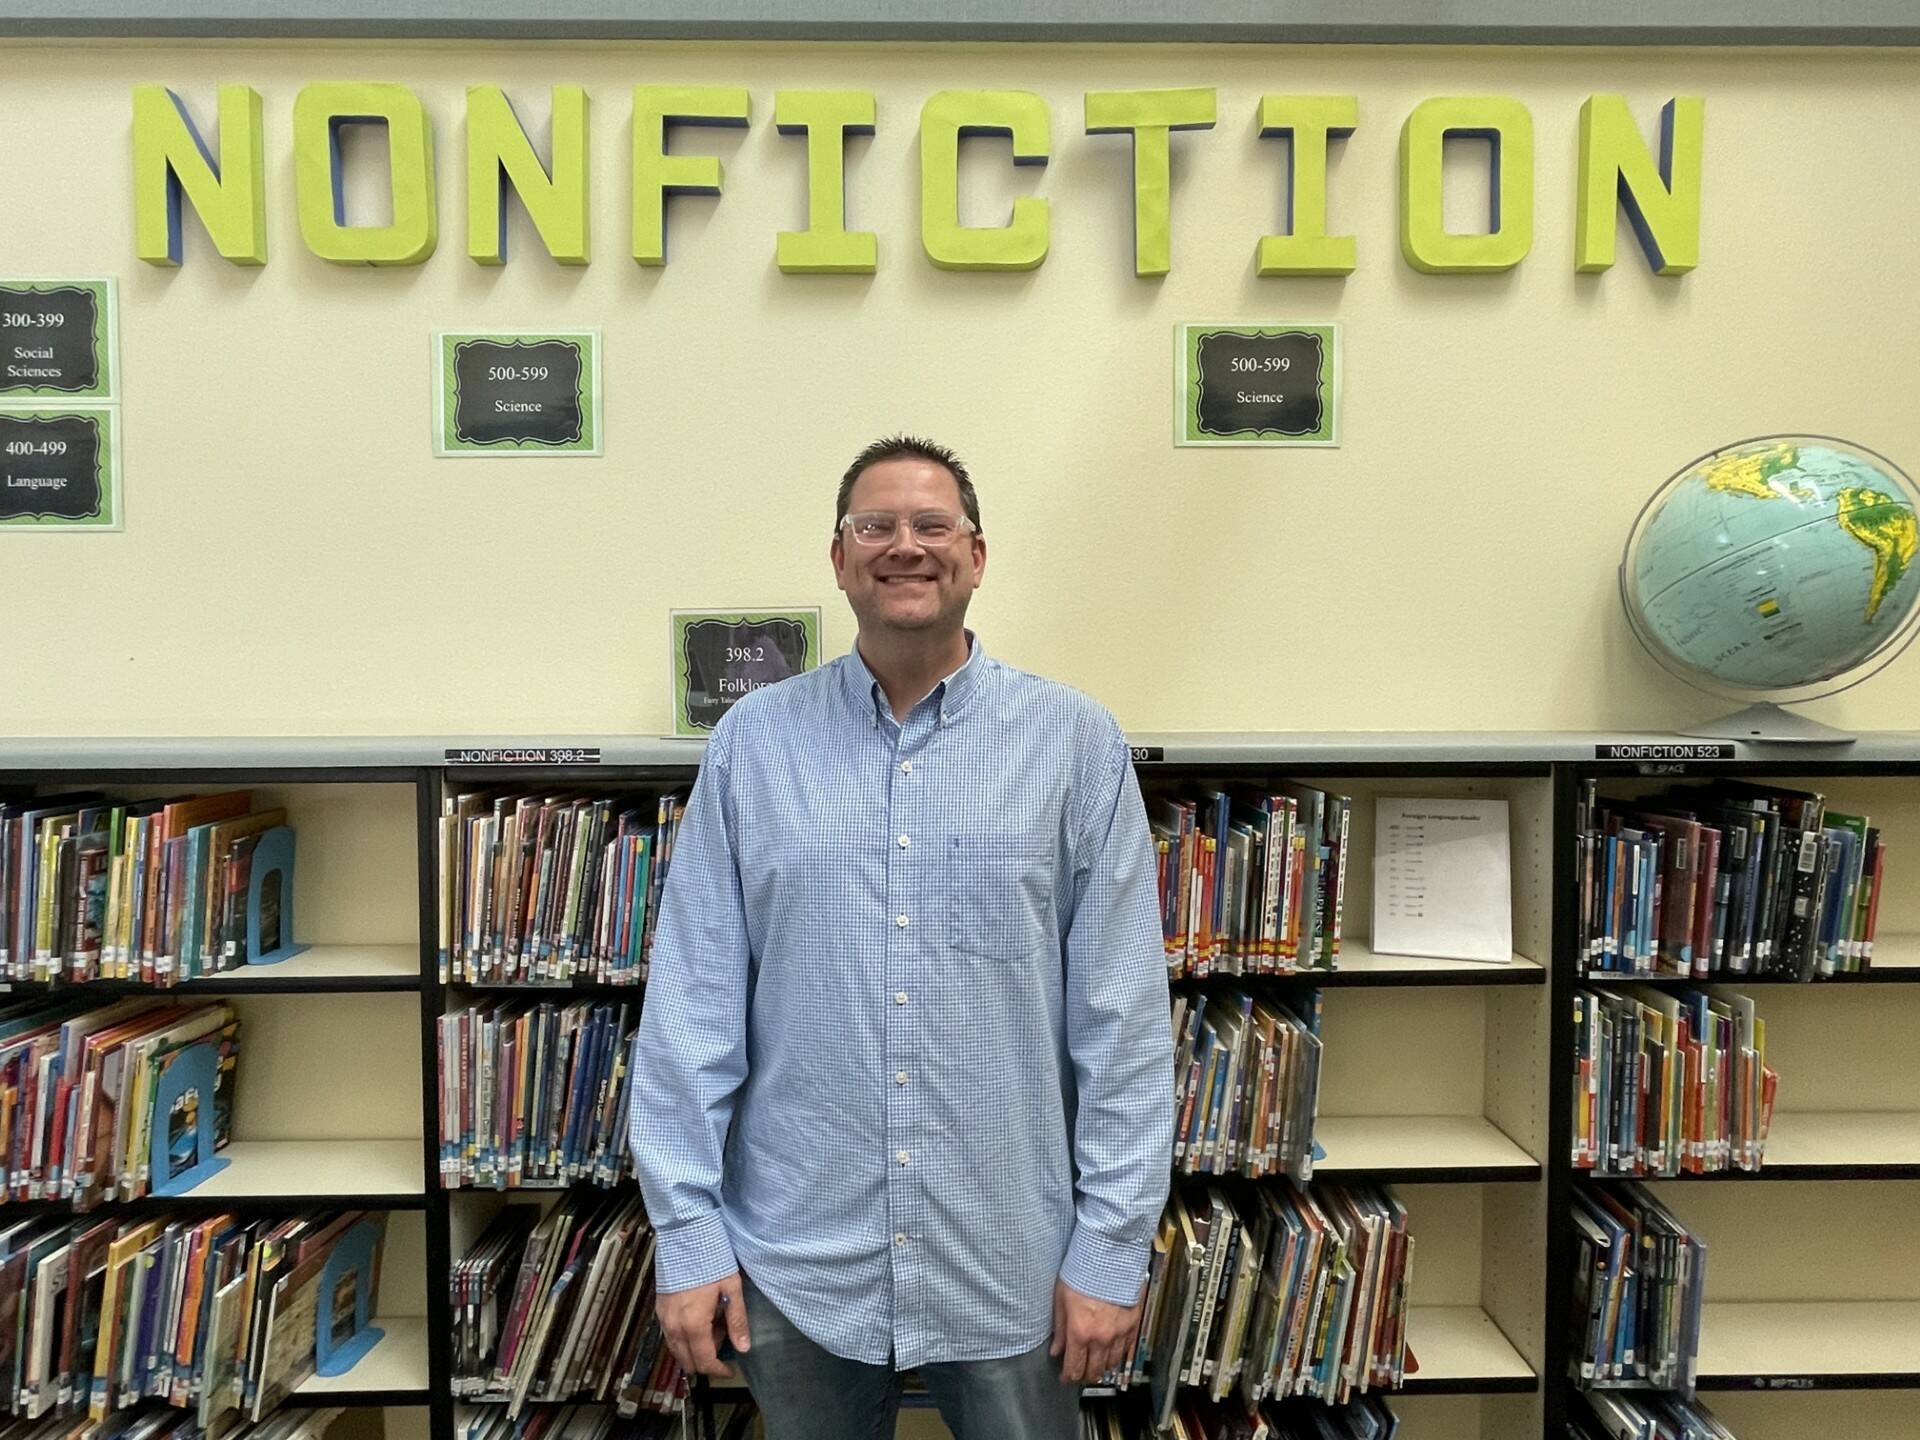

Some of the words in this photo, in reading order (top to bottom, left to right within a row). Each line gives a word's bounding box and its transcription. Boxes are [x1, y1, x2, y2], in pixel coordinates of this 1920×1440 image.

[132, 81, 1704, 276] NONFICTION
[2, 313, 65, 328] 300-399
[14, 346, 54, 359] Social
[7, 364, 62, 377] Sciences
[1231, 357, 1290, 372] 500-599
[488, 366, 548, 380] 500-599
[1236, 390, 1284, 404] Science
[495, 399, 542, 413] Science
[5, 441, 67, 455] 400-499
[7, 475, 68, 490] Language
[725, 647, 764, 662] 398.2
[460, 750, 546, 763] NONFICTION
[1610, 745, 1694, 758] NONFICTION
[1696, 745, 1720, 758] 523
